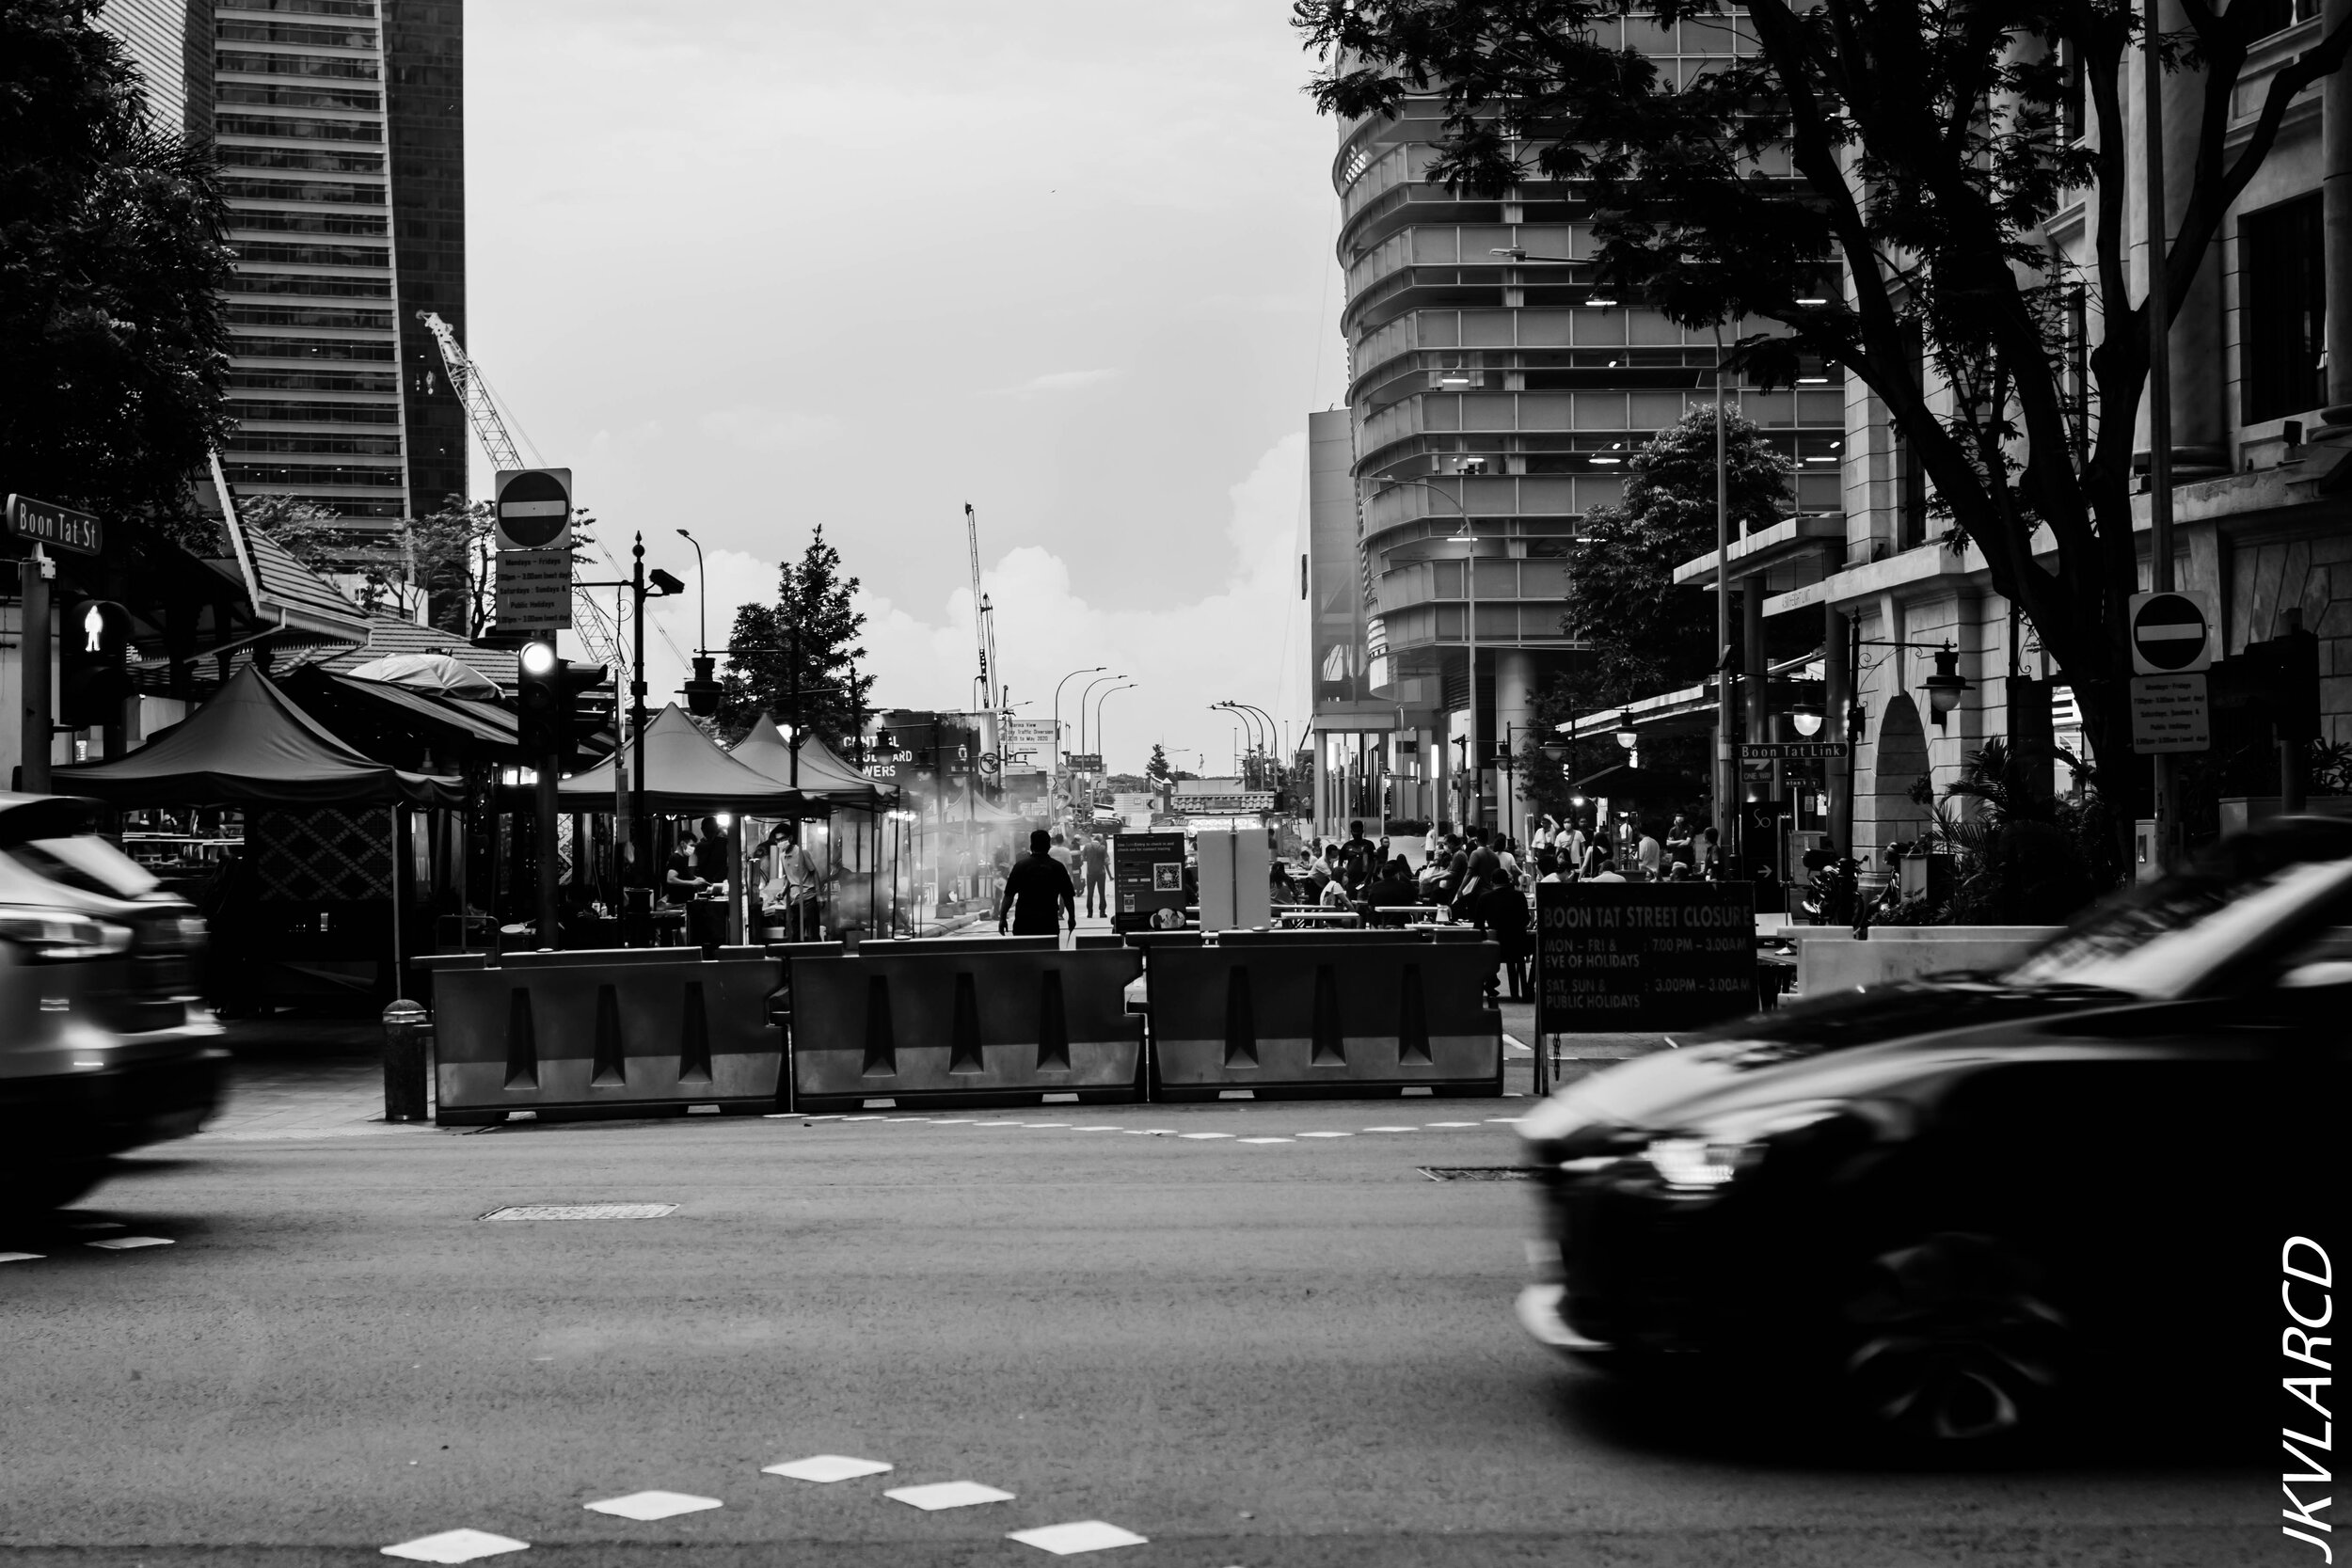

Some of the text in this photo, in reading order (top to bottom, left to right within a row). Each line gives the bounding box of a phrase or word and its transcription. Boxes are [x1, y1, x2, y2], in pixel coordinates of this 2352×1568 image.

[20, 502, 96, 549] Boon Tat St
[500, 587, 530, 595] Saturdays
[1741, 745, 1840, 757] Boon Tat Link
[1743, 772, 1756, 781] ONE
[1754, 809, 1771, 828] So
[1543, 905, 1751, 928] BOON TAT STREET CLOSURE
[1545, 939, 1573, 952] MON
[1588, 939, 1605, 952] FRI
[1706, 938, 1747, 951] 3.00AM
[1545, 954, 1640, 968] EVE OF HOLIDAYS
[1572, 979, 1595, 992] SUN
[1656, 978, 1696, 991] 3.00PM
[1708, 978, 1751, 991] 3.00AM
[1546, 995, 1641, 1008] PUBLIC HOLIDAYS
